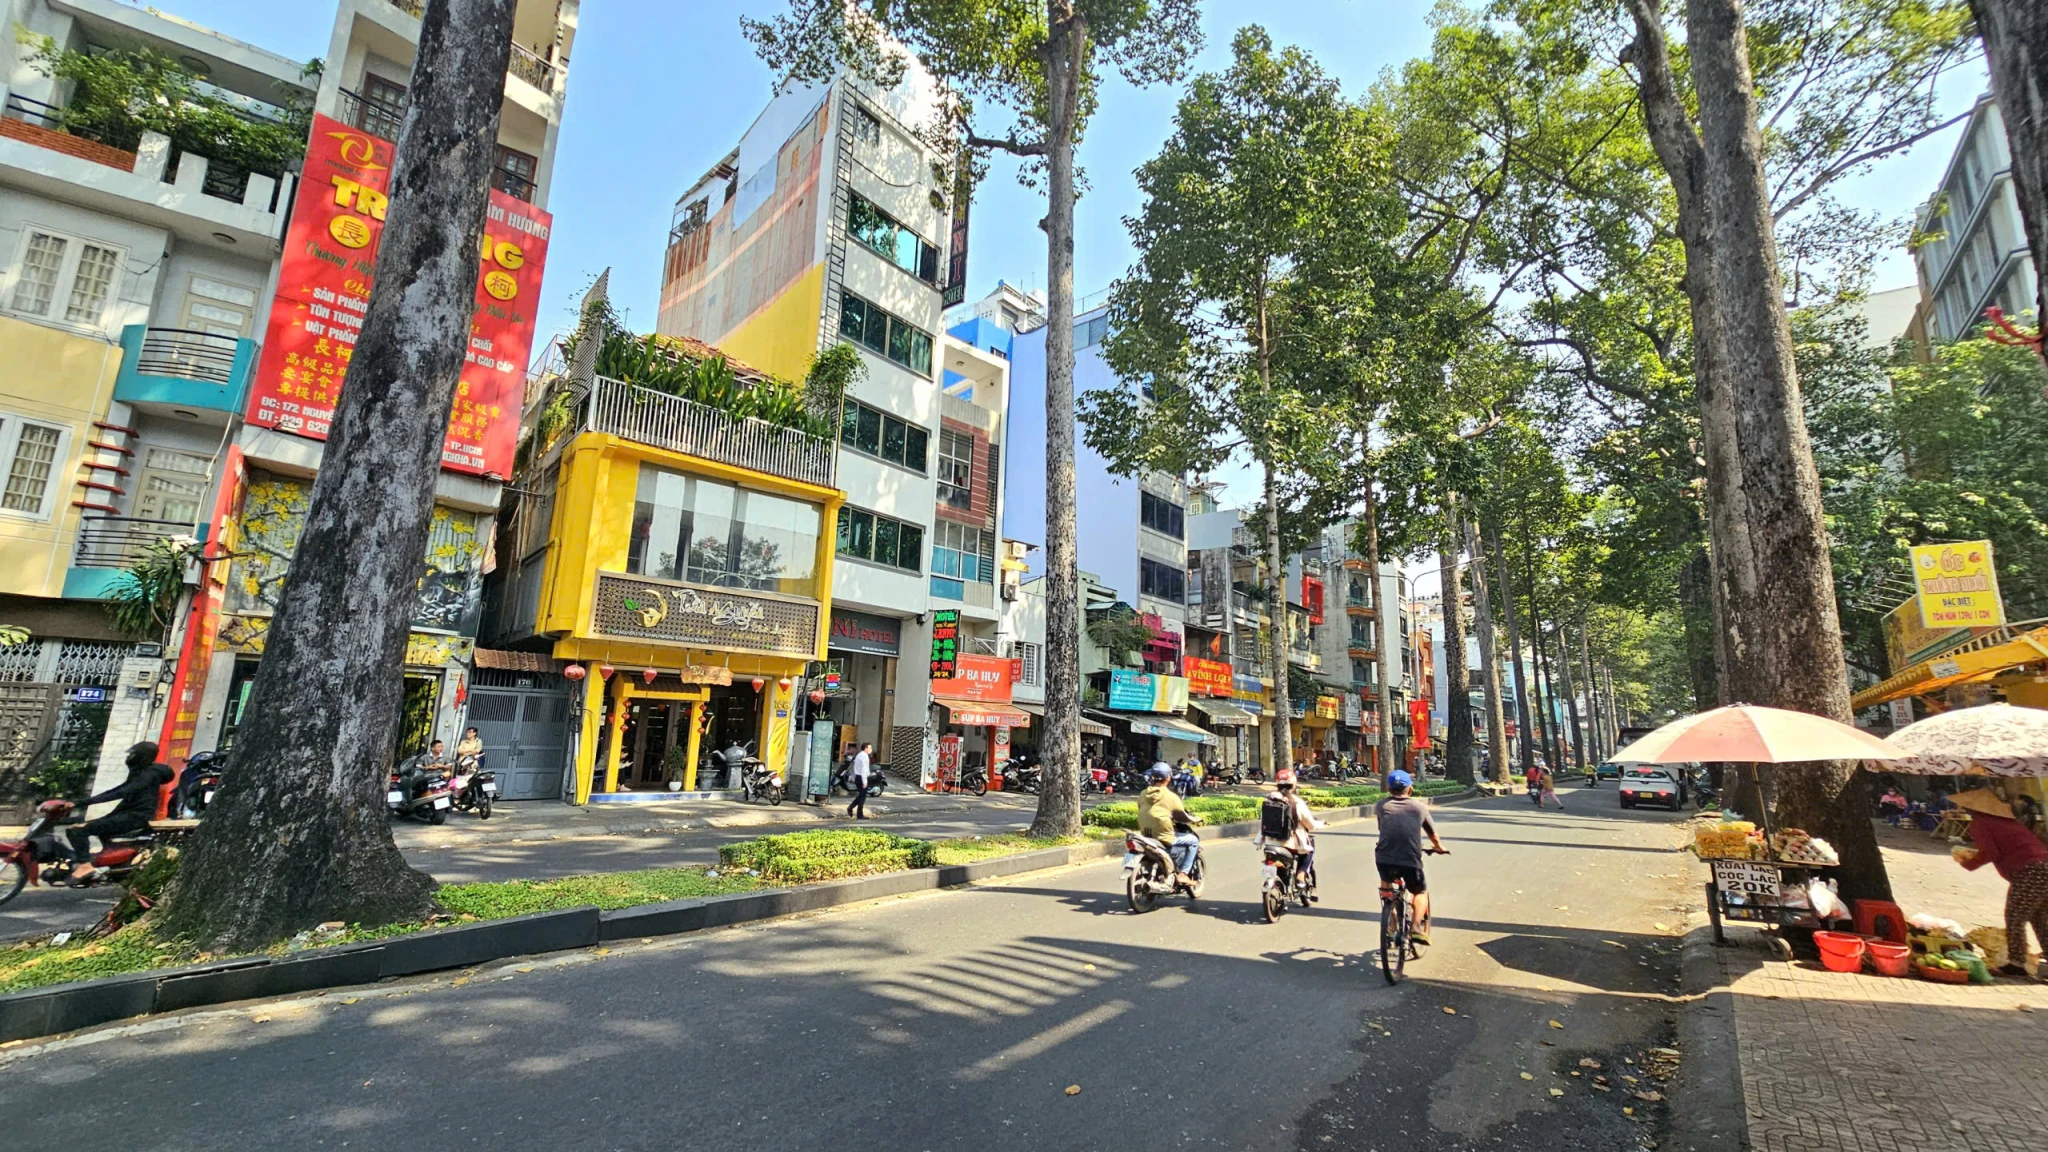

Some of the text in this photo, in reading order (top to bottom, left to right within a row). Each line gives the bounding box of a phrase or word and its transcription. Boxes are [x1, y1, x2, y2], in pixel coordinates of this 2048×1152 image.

[313, 286, 336, 304] SẢN
[310, 303, 331, 320] TÔN
[477, 354, 495, 369] CAO
[496, 360, 515, 374] CẤP
[859, 628, 896, 645] HOTEL
[967, 669, 979, 681] BA
[981, 671, 1000, 682] HUY
[986, 714, 1001, 724] HUY
[1727, 880, 1775, 895] 20K
